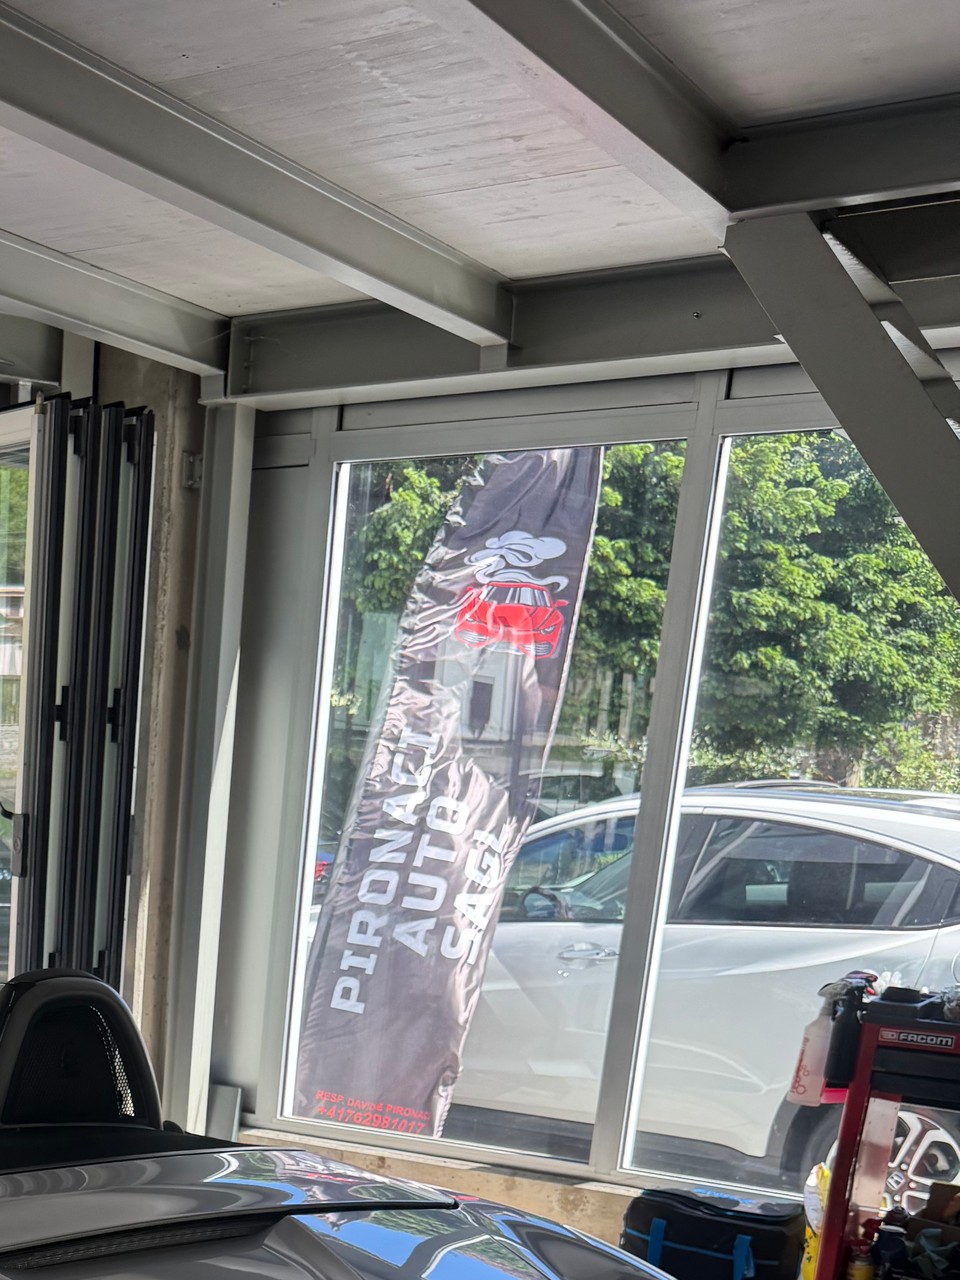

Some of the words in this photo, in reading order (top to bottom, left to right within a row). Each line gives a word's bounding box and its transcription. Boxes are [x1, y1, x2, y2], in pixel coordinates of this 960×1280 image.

[330, 726, 442, 1014] PIRONACI
[391, 795, 470, 957] AUTO
[899, 1033, 952, 1046] FACOM
[347, 1097, 383, 1112] DAVIDE
[317, 1105, 425, 1135] +41762981017
